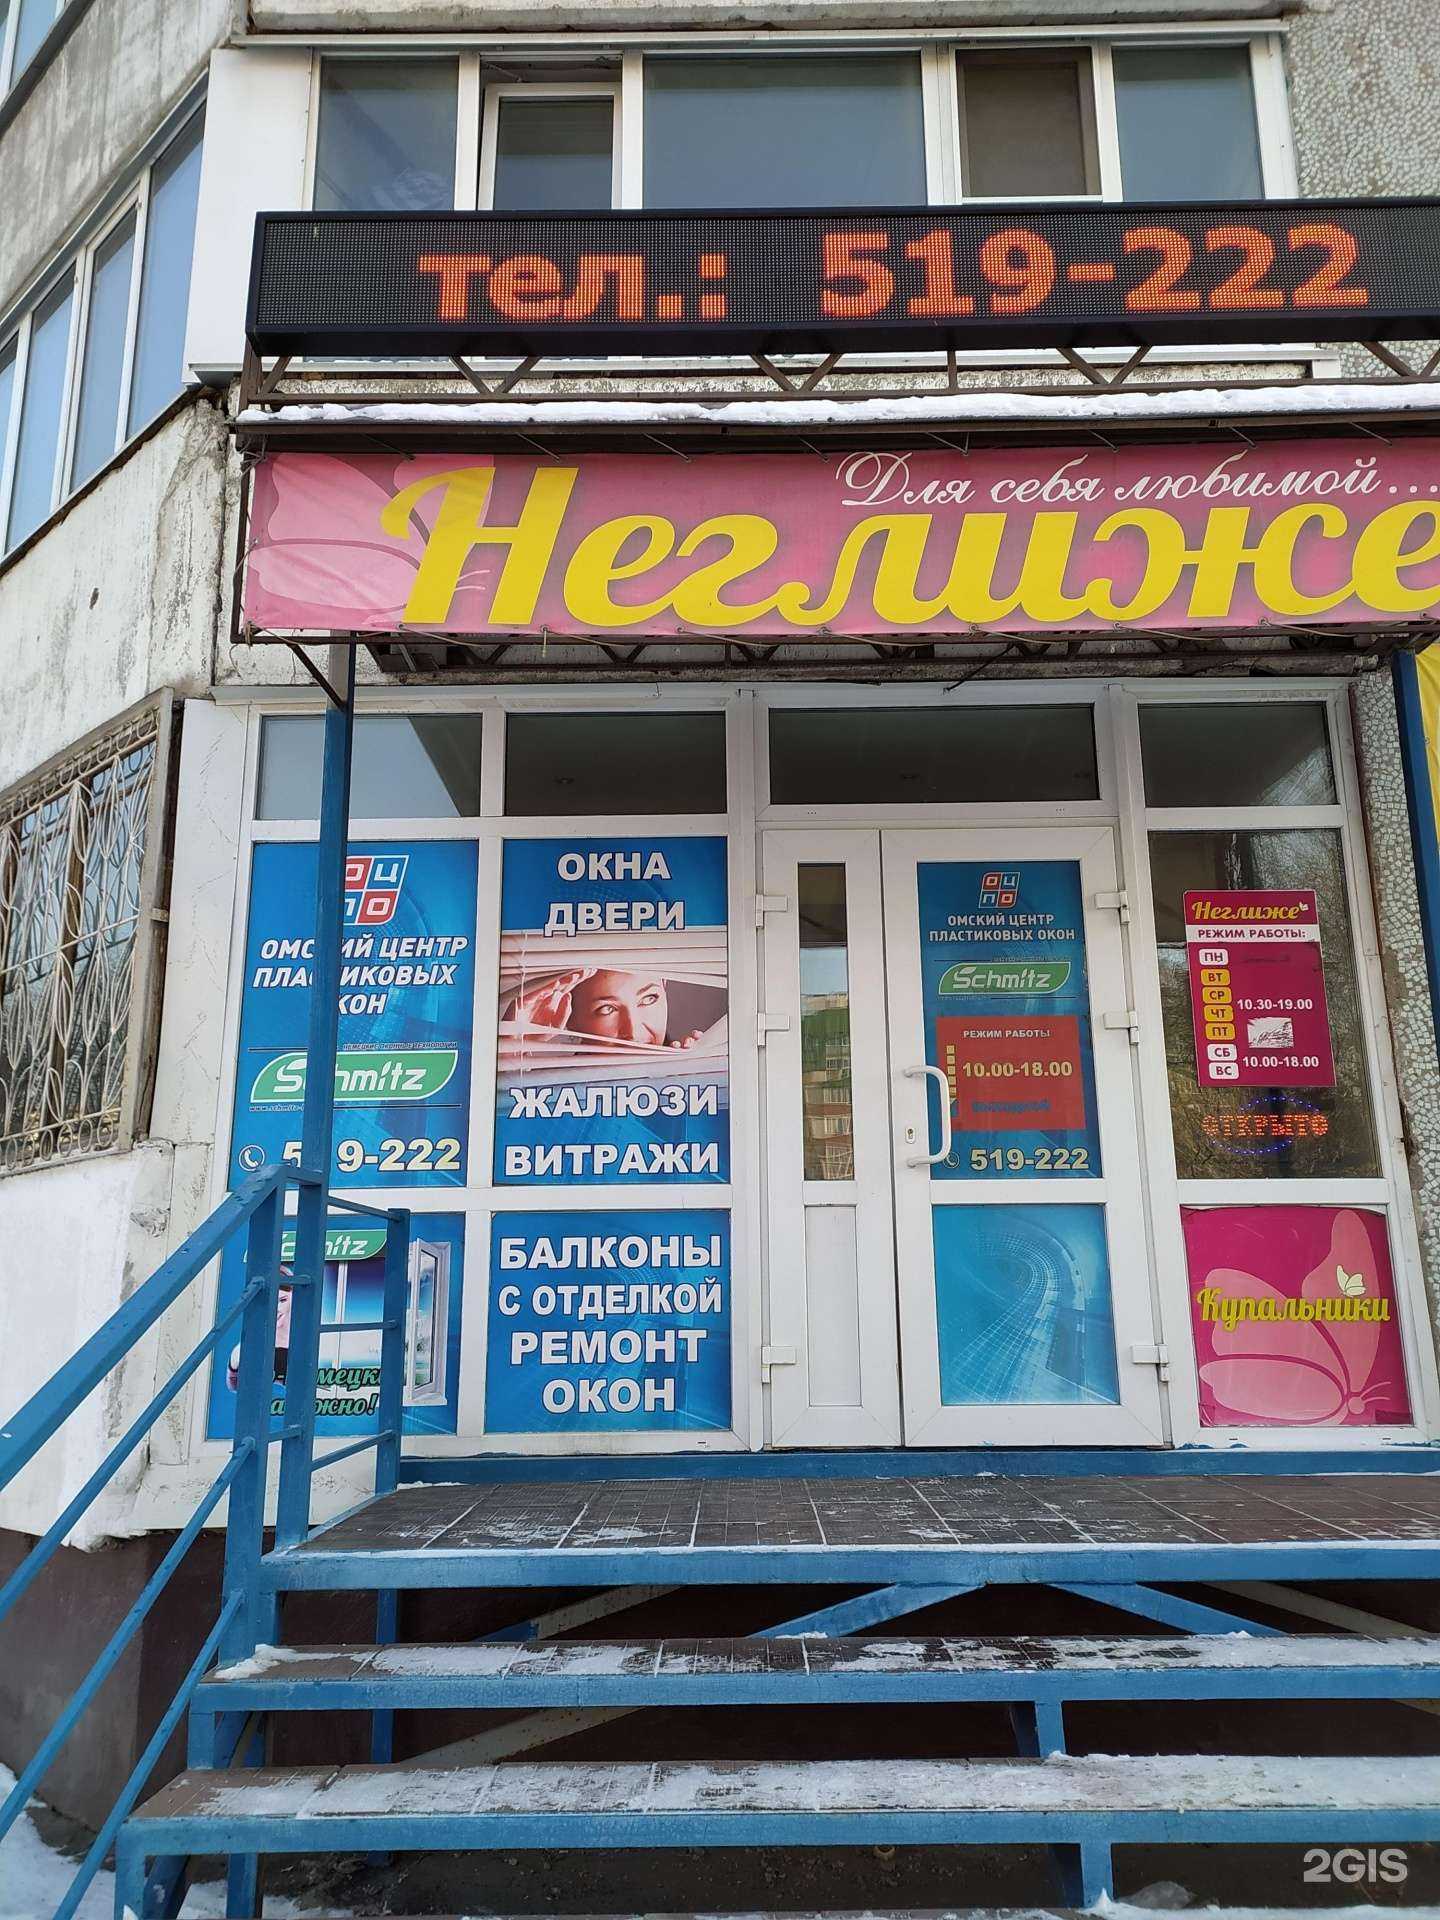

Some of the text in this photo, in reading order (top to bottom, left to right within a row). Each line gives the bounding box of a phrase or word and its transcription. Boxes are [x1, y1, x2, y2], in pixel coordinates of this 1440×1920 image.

[416, 224, 1369, 320] тел.: 519-222
[836, 451, 975, 506] Для
[990, 450, 1105, 503] себя
[379, 467, 1440, 627] Неглиже
[556, 852, 672, 881] ОКНА
[543, 901, 686, 938] ДВЕРИ
[947, 912, 1055, 928] ОМСКИЙ ЦЕНТР
[1191, 901, 1301, 920] Неглиже
[929, 928, 1075, 942] ПЛАСТИКОВЫХ ОКОН
[1197, 928, 1307, 940] РЕЖИМ РАБОТЫ:
[260, 933, 469, 961] ОМСИЙ ЦЕНТР
[1203, 951, 1224, 963] ПН
[252, 964, 458, 988] ПЛАИКОВЫХ
[952, 965, 1052, 989] Schmitz
[1207, 972, 1223, 982] ВТ
[338, 993, 388, 1016] КОН
[1208, 990, 1226, 1000] СР
[1236, 998, 1313, 1011] 10.30-19.00
[1210, 1008, 1226, 1018] ЧТ
[963, 1028, 1003, 1039] РЕЖИМ
[1211, 1026, 1227, 1037] ПТ
[1213, 1047, 1231, 1058] СБ
[1242, 1055, 1320, 1068] 10.00-18.00
[272, 1057, 428, 1094] Shmitz
[962, 1061, 1073, 1078] 10.00-18.00
[1215, 1065, 1233, 1076] ВС
[508, 1085, 719, 1119] ЖАЛЮЗИ
[1201, 1113, 1329, 1137] ОТКРЫТО
[282, 1138, 462, 1172] 59-222
[504, 1142, 720, 1177] ВИТРАЖИ
[969, 1147, 1090, 1171] 519-222
[498, 1234, 722, 1270] БАЛКОНЫ
[497, 1276, 723, 1321] С ОТДЕЛКОЙ
[1196, 1287, 1391, 1332] Купальники
[510, 1329, 709, 1366] РЕМОНТ
[542, 1377, 676, 1414] ОКОН
